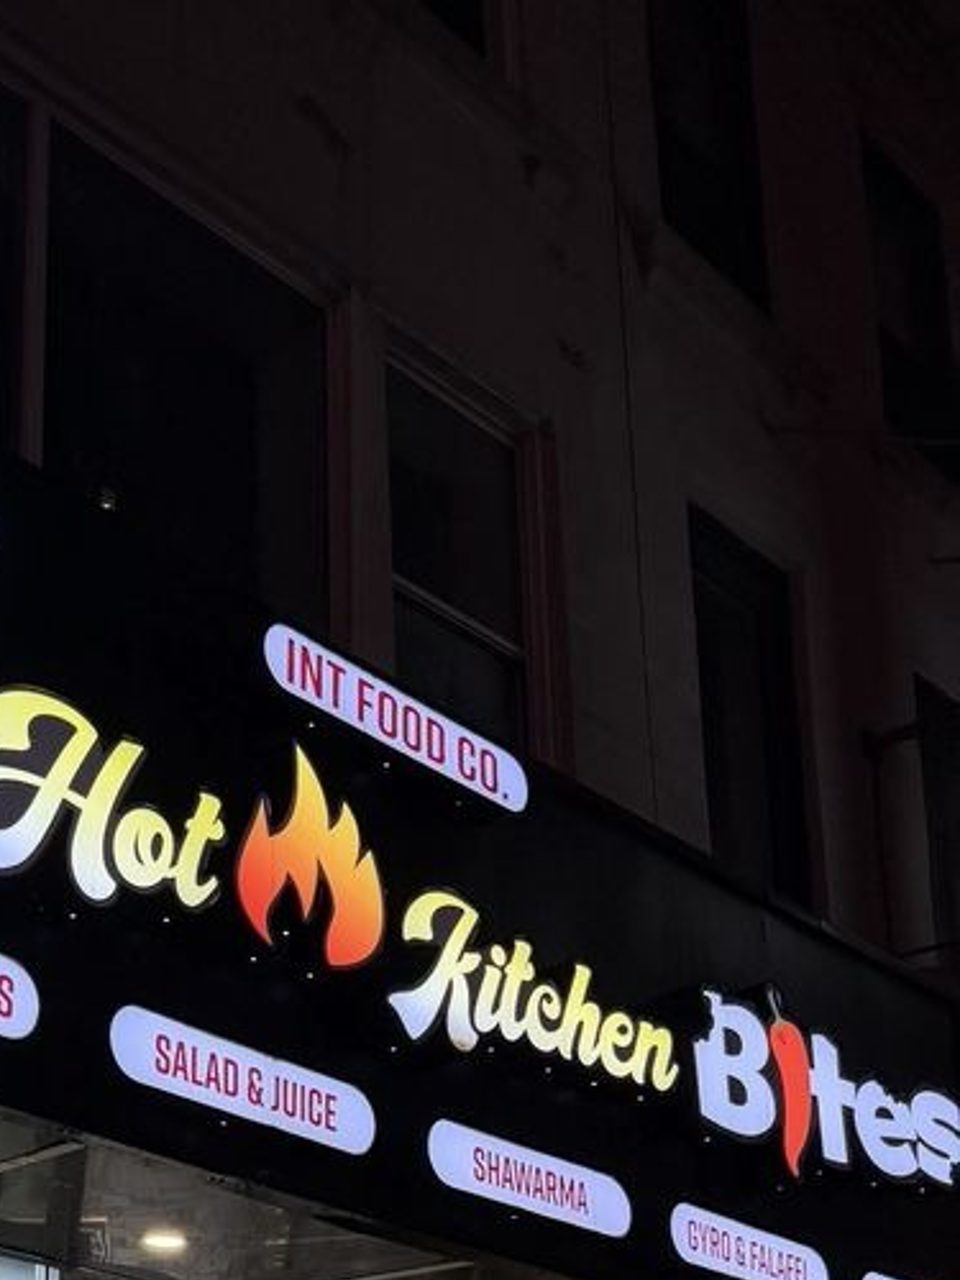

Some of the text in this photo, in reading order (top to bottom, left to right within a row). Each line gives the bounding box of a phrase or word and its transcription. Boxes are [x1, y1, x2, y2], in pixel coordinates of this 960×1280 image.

[284, 637, 511, 800] INT FOOD CO.
[387, 890, 679, 1092] Kitchen
[154, 1034, 338, 1133] SALAD & JUICE
[472, 1146, 590, 1216] SHAWARMA
[687, 1220, 731, 1263] GYRO
[736, 1236, 746, 1267] &
